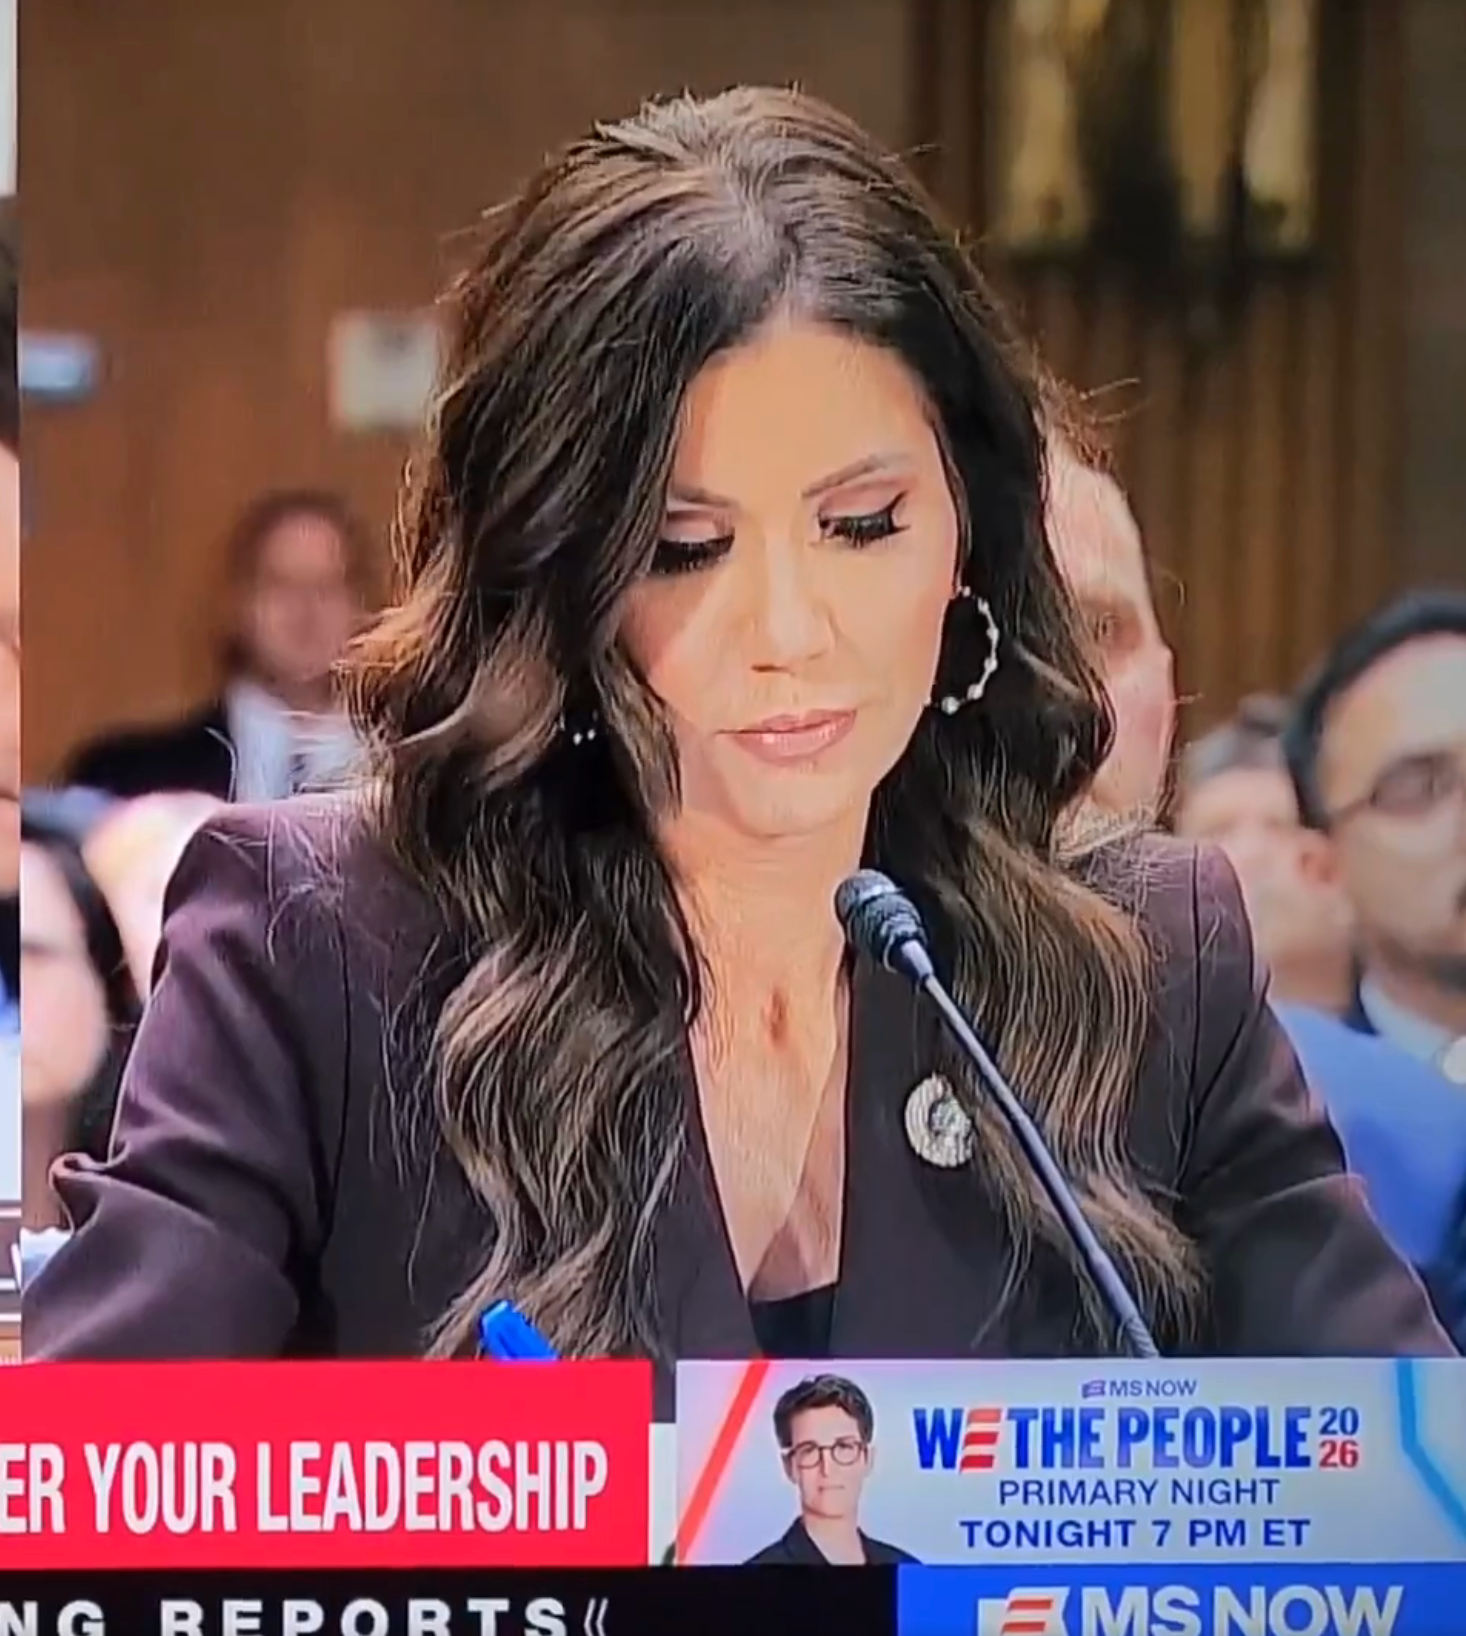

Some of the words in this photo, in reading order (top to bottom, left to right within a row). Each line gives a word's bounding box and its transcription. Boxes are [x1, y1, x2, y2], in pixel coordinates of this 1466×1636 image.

[1318, 1405, 1360, 1436] 20
[913, 1407, 1002, 1472] WE
[1006, 1406, 1106, 1470] THE
[1116, 1405, 1312, 1470] PEOPLE
[1318, 1438, 1360, 1469] 26
[83, 1441, 237, 1535] YOUR
[257, 1439, 609, 1533] LEADERSHIP
[999, 1478, 1160, 1506] PRIMARY
[1171, 1478, 1281, 1506] NIGHT
[959, 1518, 1137, 1549] TONIGHT
[1151, 1518, 1173, 1549] 7
[1188, 1518, 1247, 1549] PM
[1262, 1518, 1312, 1549] ET
[160, 1597, 567, 1636] REPORTS
[1081, 1585, 1202, 1636] MS
[1213, 1585, 1404, 1636] NOW
